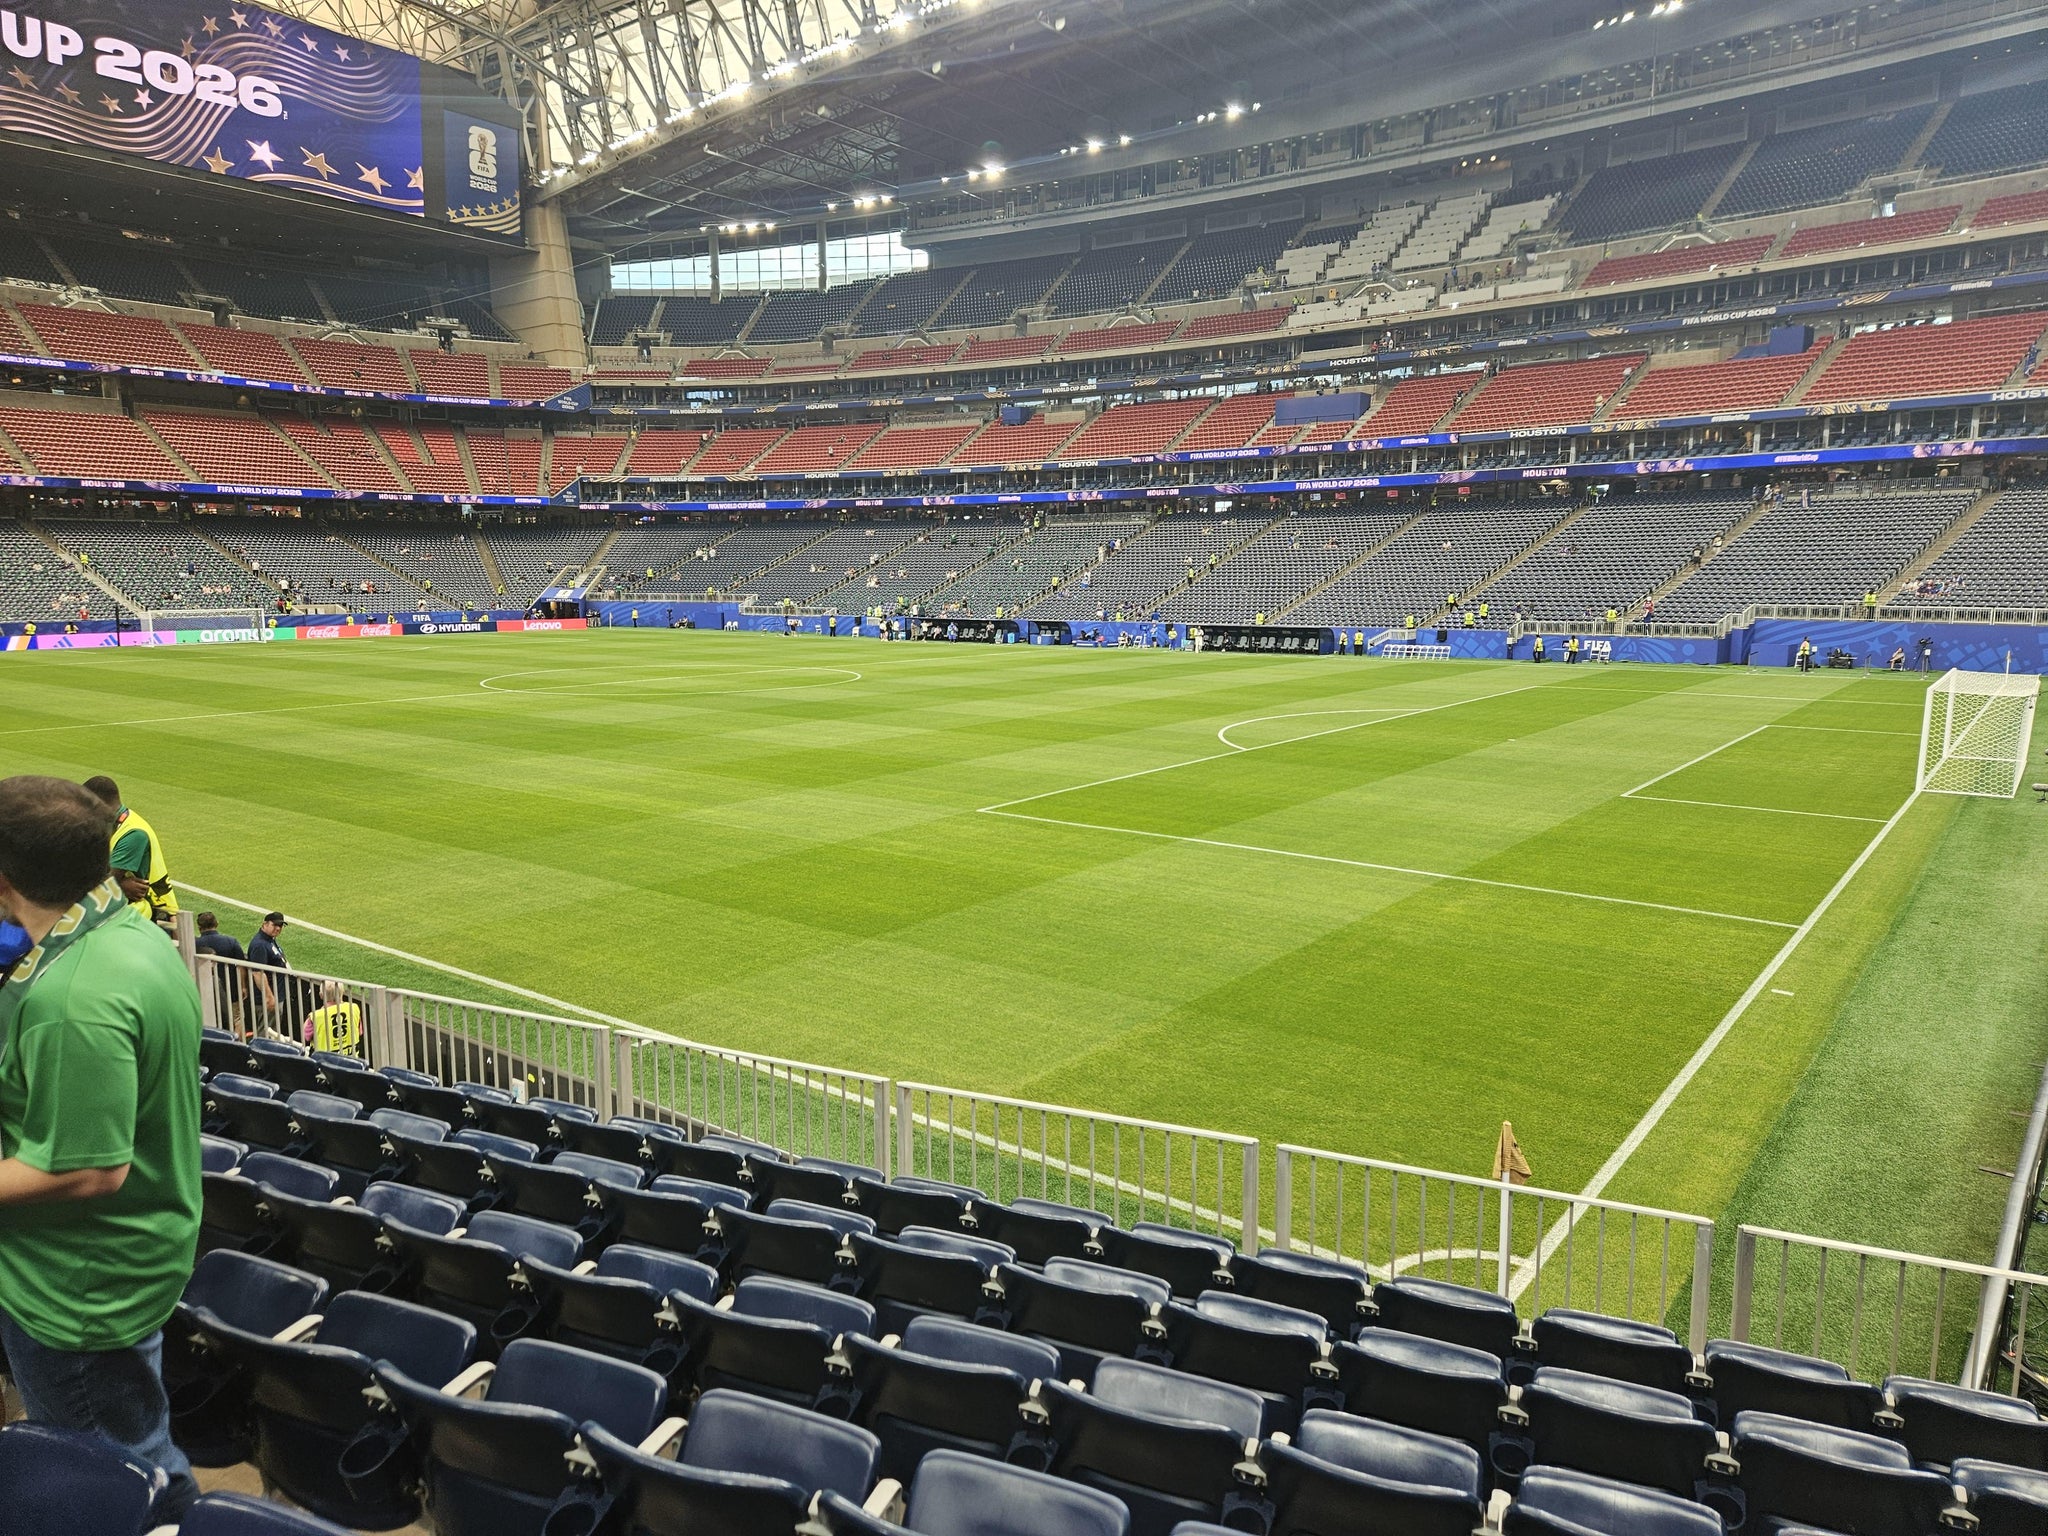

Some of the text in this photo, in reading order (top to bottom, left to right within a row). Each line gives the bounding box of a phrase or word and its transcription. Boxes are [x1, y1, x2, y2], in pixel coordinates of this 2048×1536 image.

[1, 10, 283, 118] UP 2026
[477, 165, 490, 173] FIFA
[469, 174, 487, 183] WORLD
[469, 180, 498, 194] 2026
[1682, 307, 1777, 325] FIFA WORLD CUP 2026
[0, 355, 24, 363] WORLD
[1329, 356, 1375, 367] HOUSTON
[130, 368, 165, 377] HOUSTON
[344, 390, 374, 398] HOUSTON
[1992, 389, 2048, 401] HOUST
[805, 403, 838, 411] HOUSTON
[1510, 427, 1567, 438] HOUSTON
[1299, 444, 1332, 453] HOUSTON
[1190, 452, 1203, 460] FIFA
[1203, 451, 1225, 459] WORLD
[1238, 449, 1260, 457] 2026
[1058, 460, 1099, 468] HOUSTON
[804, 472, 839, 480] HOUSTON
[1522, 468, 1567, 478] HOUSTON
[81, 480, 125, 489] HOUSTON
[1311, 481, 1337, 489] WORLD
[1338, 480, 1353, 488] CUP
[1353, 479, 1380, 487] 2026
[234, 486, 261, 494] WORLD
[277, 488, 303, 496] 2026
[1147, 488, 1179, 496] HOUSTON
[378, 493, 414, 501] HOUSTON
[413, 614, 431, 622] FIFA
[438, 623, 481, 632] HYUNDAI
[523, 620, 562, 631] Lenovo
[1583, 640, 1612, 651] FIFA
